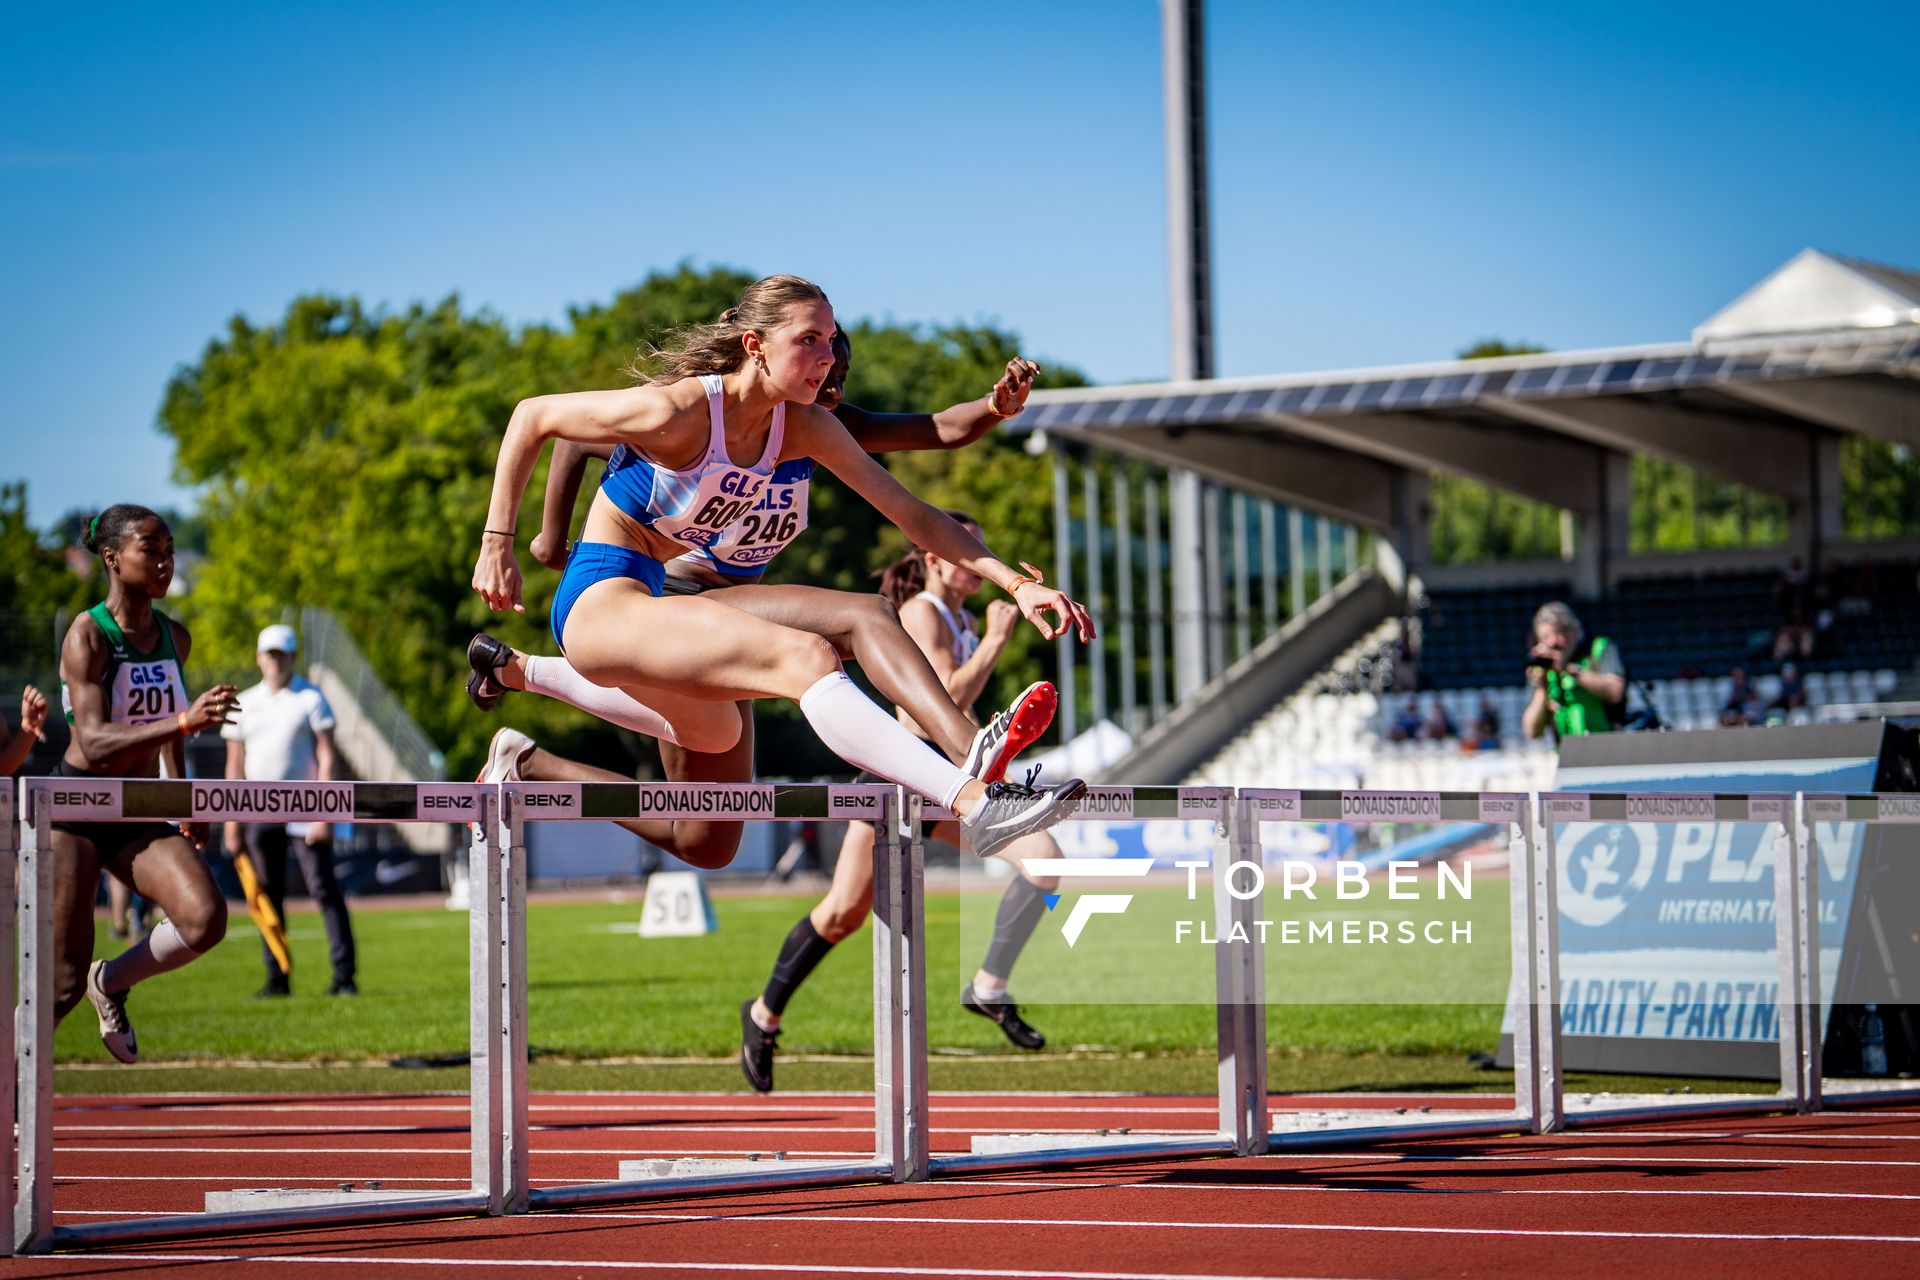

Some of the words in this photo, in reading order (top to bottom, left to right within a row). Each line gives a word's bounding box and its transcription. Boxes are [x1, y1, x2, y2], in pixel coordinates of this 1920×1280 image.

[737, 512, 798, 546] 246
[127, 684, 175, 716] 201
[53, 792, 111, 805] BENZ
[194, 788, 352, 813] DONAUSTADION
[423, 796, 473, 808] BENZ
[525, 794, 573, 807] BENZ
[641, 790, 773, 812] DONAUSTADION
[833, 796, 875, 808] BENZ
[1182, 797, 1217, 809] BENZ
[1259, 798, 1294, 809] BENZ
[1343, 796, 1439, 815] DONAUSTADION
[1483, 801, 1514, 811] BENZ
[1552, 801, 1584, 812] BENZ
[1628, 797, 1714, 816] DONAUSTADION
[653, 888, 690, 925] 50
